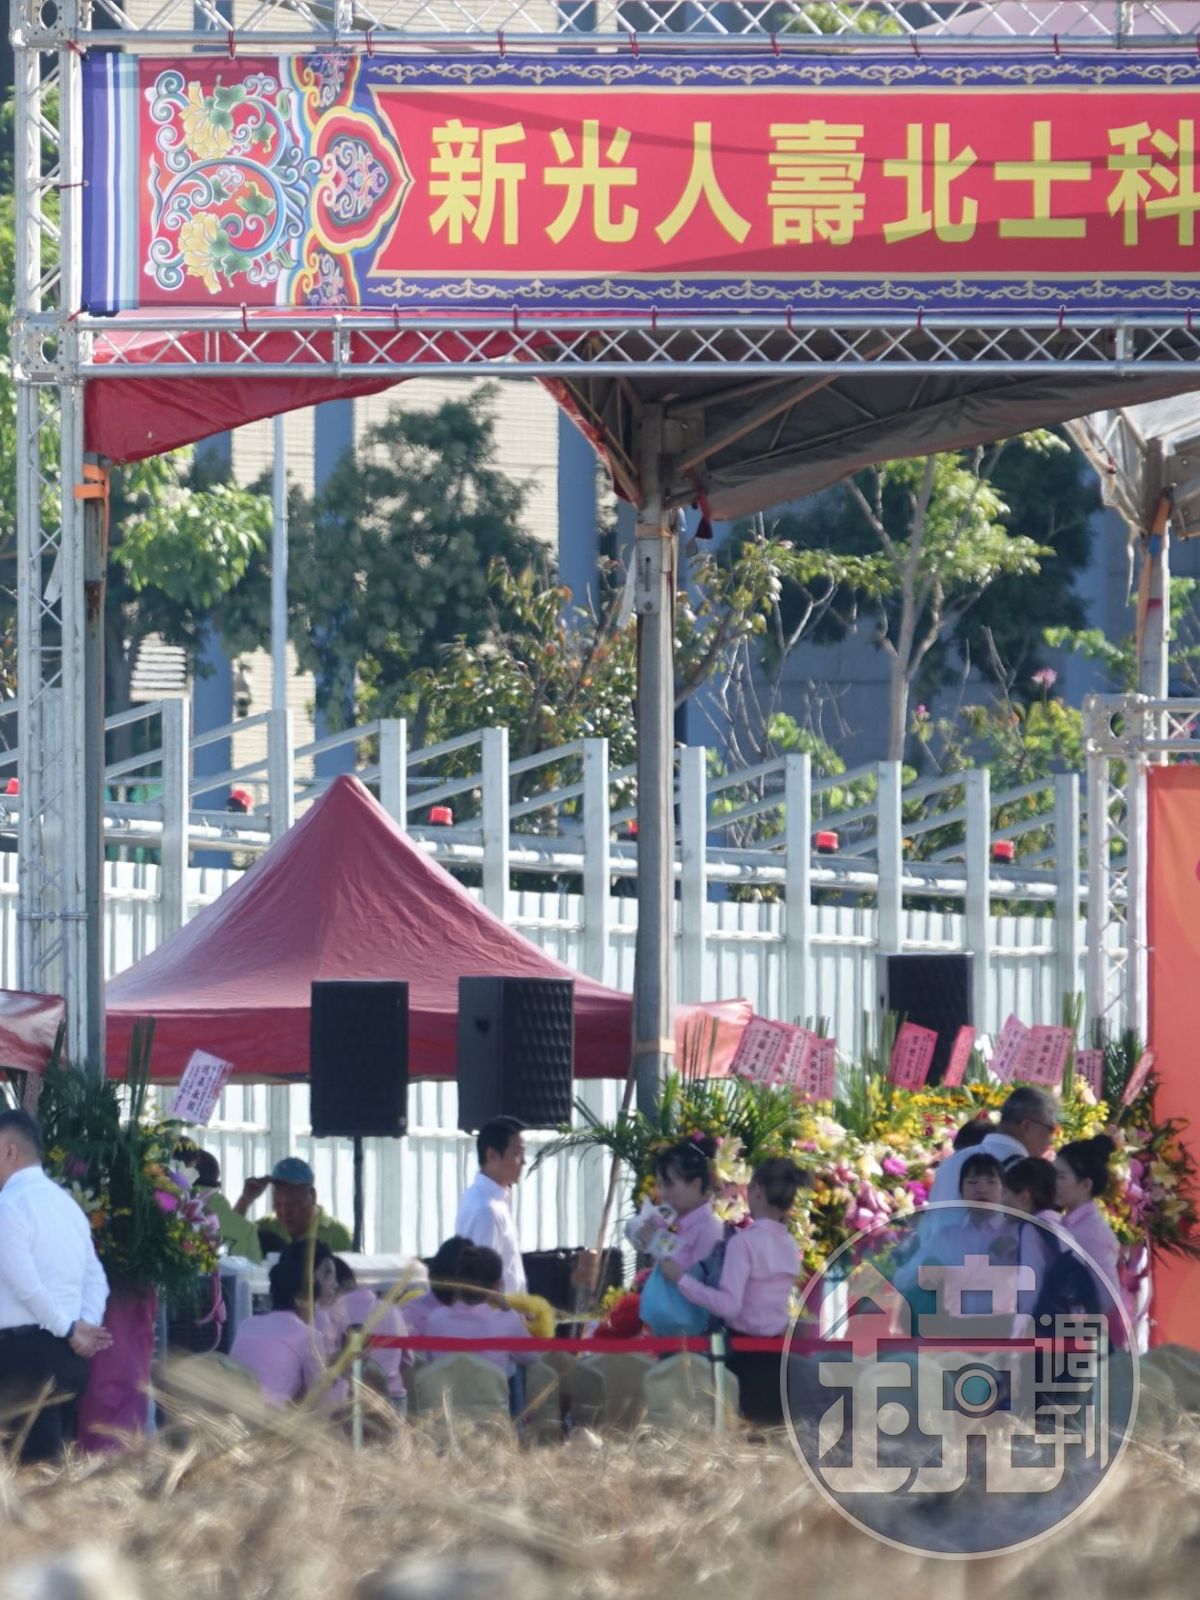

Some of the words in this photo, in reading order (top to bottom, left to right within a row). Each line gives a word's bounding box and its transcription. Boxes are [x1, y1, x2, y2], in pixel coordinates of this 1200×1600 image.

[429, 118, 1200, 245] 新光人壽北士科
